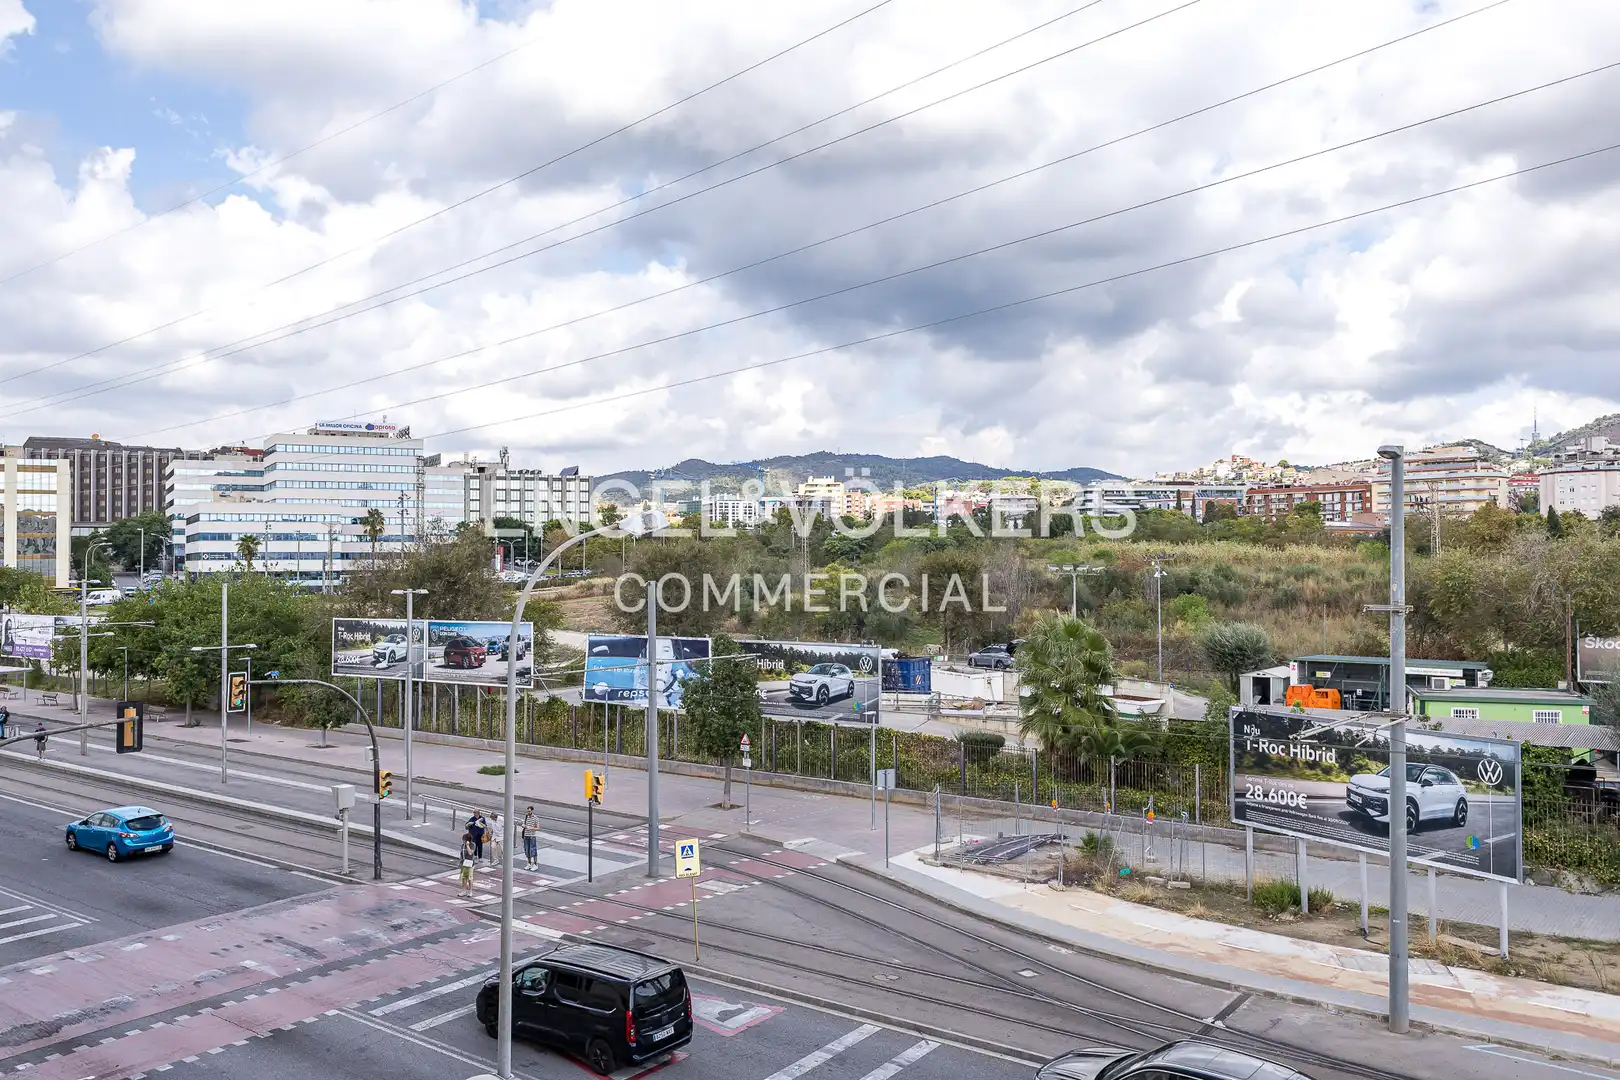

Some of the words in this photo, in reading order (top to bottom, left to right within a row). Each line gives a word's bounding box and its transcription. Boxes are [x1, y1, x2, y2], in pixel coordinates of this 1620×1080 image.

[1244, 736, 1286, 756] T-Roc
[1290, 742, 1336, 764] Híbrid
[1245, 783, 1308, 810] 28.600€
